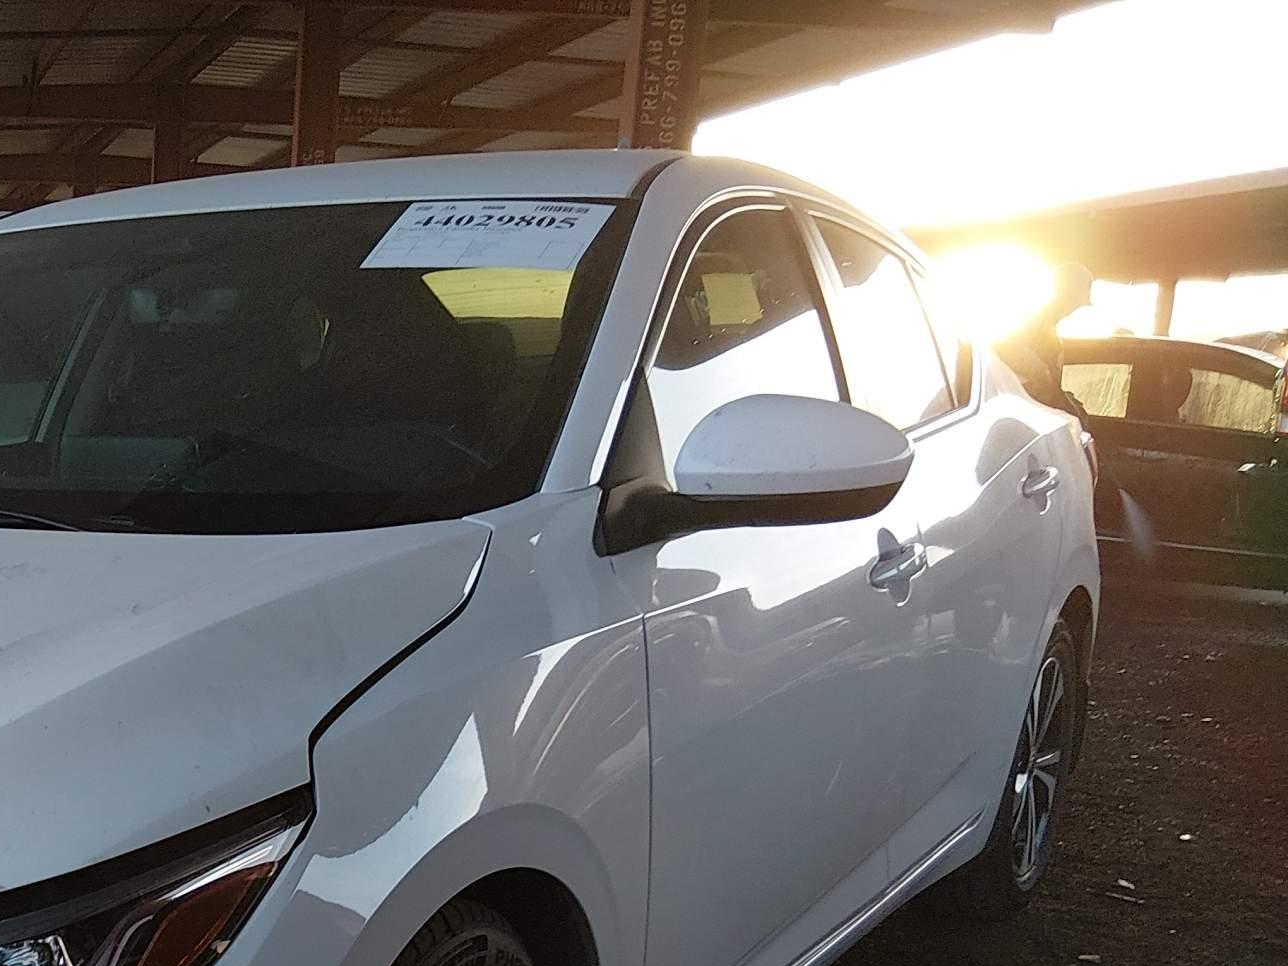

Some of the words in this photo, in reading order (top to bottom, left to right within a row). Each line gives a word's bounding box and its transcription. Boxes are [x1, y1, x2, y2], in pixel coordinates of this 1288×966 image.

[649, 0, 668, 26] IN
[641, 39, 663, 125] PREFAB
[414, 213, 580, 230] 44029805
